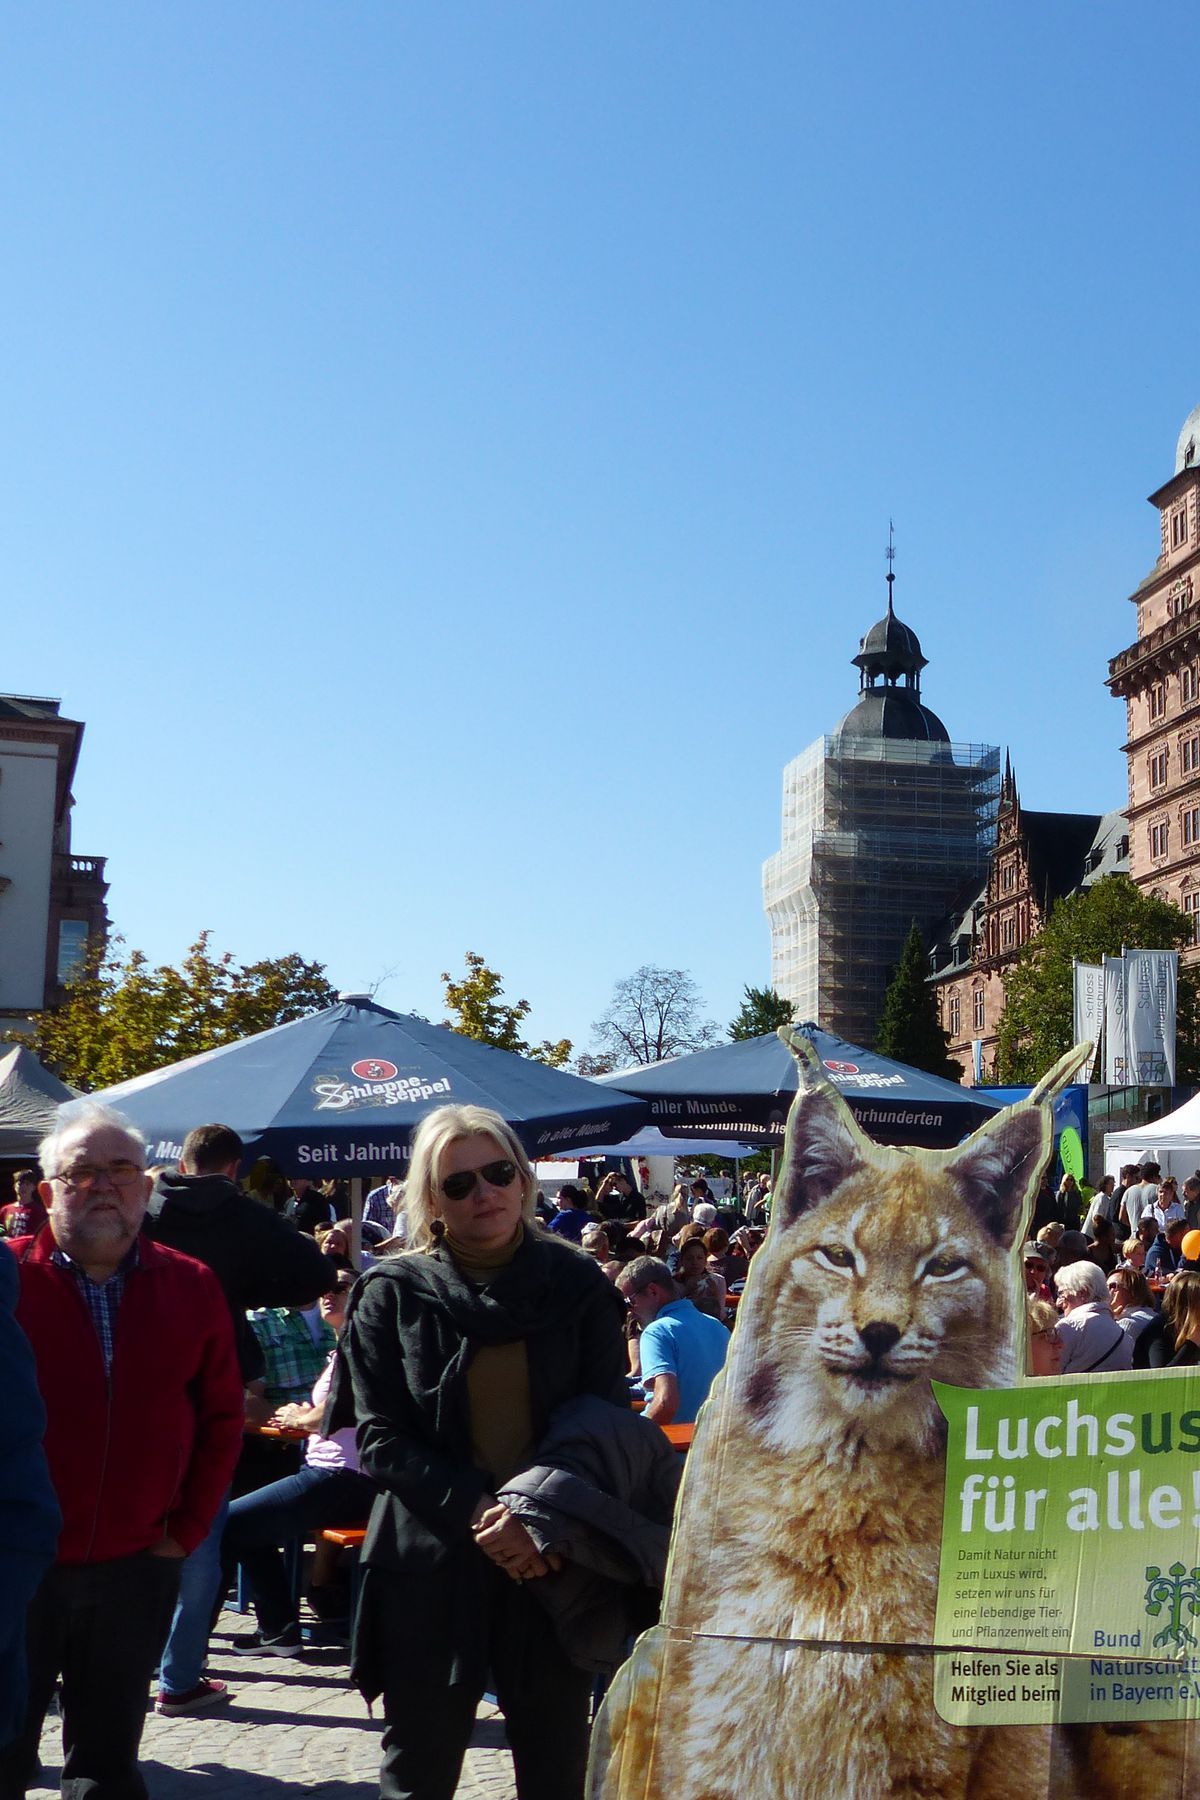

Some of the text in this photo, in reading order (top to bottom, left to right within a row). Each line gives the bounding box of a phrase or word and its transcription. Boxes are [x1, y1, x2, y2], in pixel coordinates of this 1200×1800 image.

[1086, 972, 1094, 1019] Schloss
[315, 1076, 428, 1110] Schlappe-
[652, 1100, 742, 1114] aller Munde.
[298, 1144, 338, 1163] Seit
[960, 1474, 1047, 1532] für
[958, 1548, 1057, 1560] Damit Natur nicht
[956, 1568, 1047, 1580] zum Luxus wird,
[955, 1587, 1056, 1599] setzen wir uns für
[953, 1606, 1063, 1620] eine lebendige Tier-
[952, 1626, 972, 1638] und
[976, 1626, 1048, 1638] Pflanzenwelt
[1094, 1628, 1141, 1647] Bund
[951, 1659, 1059, 1676] Helfen Sie als
[951, 1685, 1061, 1706] Mitglied beim
[1090, 1682, 1106, 1700] in
[1112, 1682, 1174, 1704] Bayern
